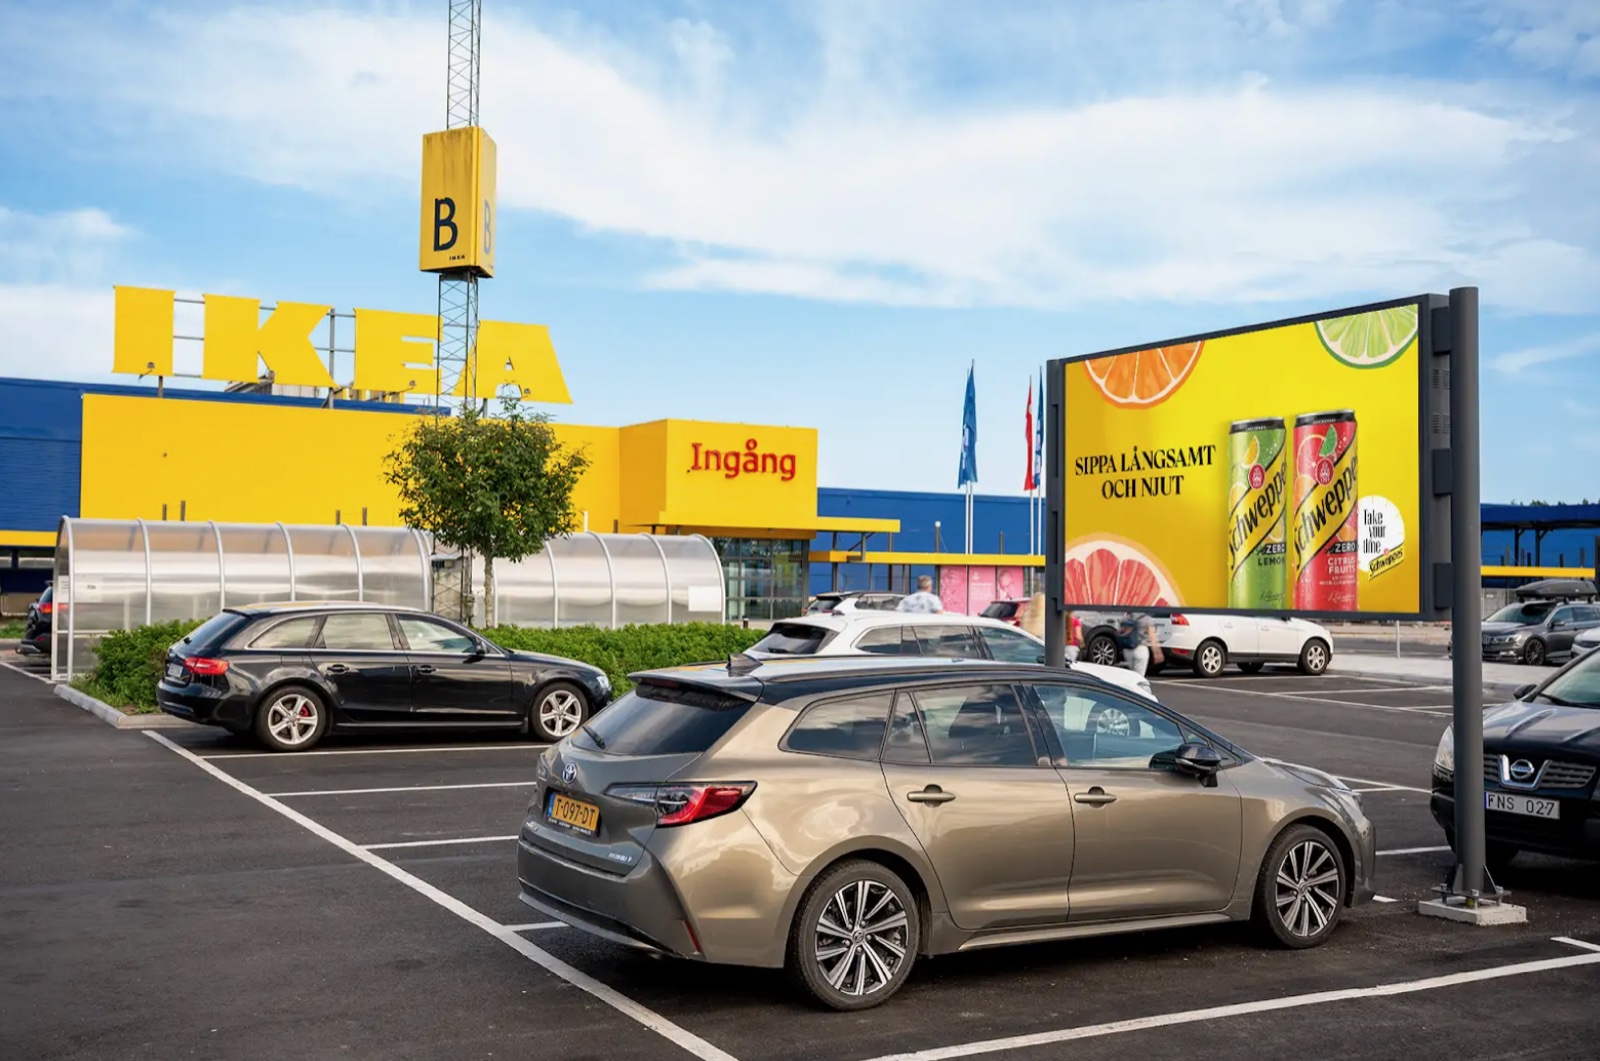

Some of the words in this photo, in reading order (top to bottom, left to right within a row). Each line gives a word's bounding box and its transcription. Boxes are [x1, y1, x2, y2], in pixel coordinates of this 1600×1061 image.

[433, 197, 458, 252] B
[483, 198, 491, 255] B
[113, 285, 573, 404] IKEA
[691, 438, 796, 481] Ingång
[1075, 454, 1117, 476] SIPPA
[1120, 445, 1216, 472] LÅNGSAMT
[1101, 478, 1137, 499] OCH
[1141, 475, 1184, 497] NJUT
[1228, 461, 1286, 571] Schweppe
[1294, 456, 1357, 571] Schweppe
[1363, 509, 1383, 526] Take
[1363, 538, 1381, 554] time
[1368, 525, 1386, 540] your
[1327, 556, 1356, 566] CITRUS
[1335, 542, 1356, 553] ZERO
[1328, 564, 1356, 575] FRUITS
[1369, 549, 1403, 577] Schweppes
[555, 798, 596, 827] T-097-DT
[1488, 794, 1515, 811] FNS
[1526, 799, 1555, 816] 027
